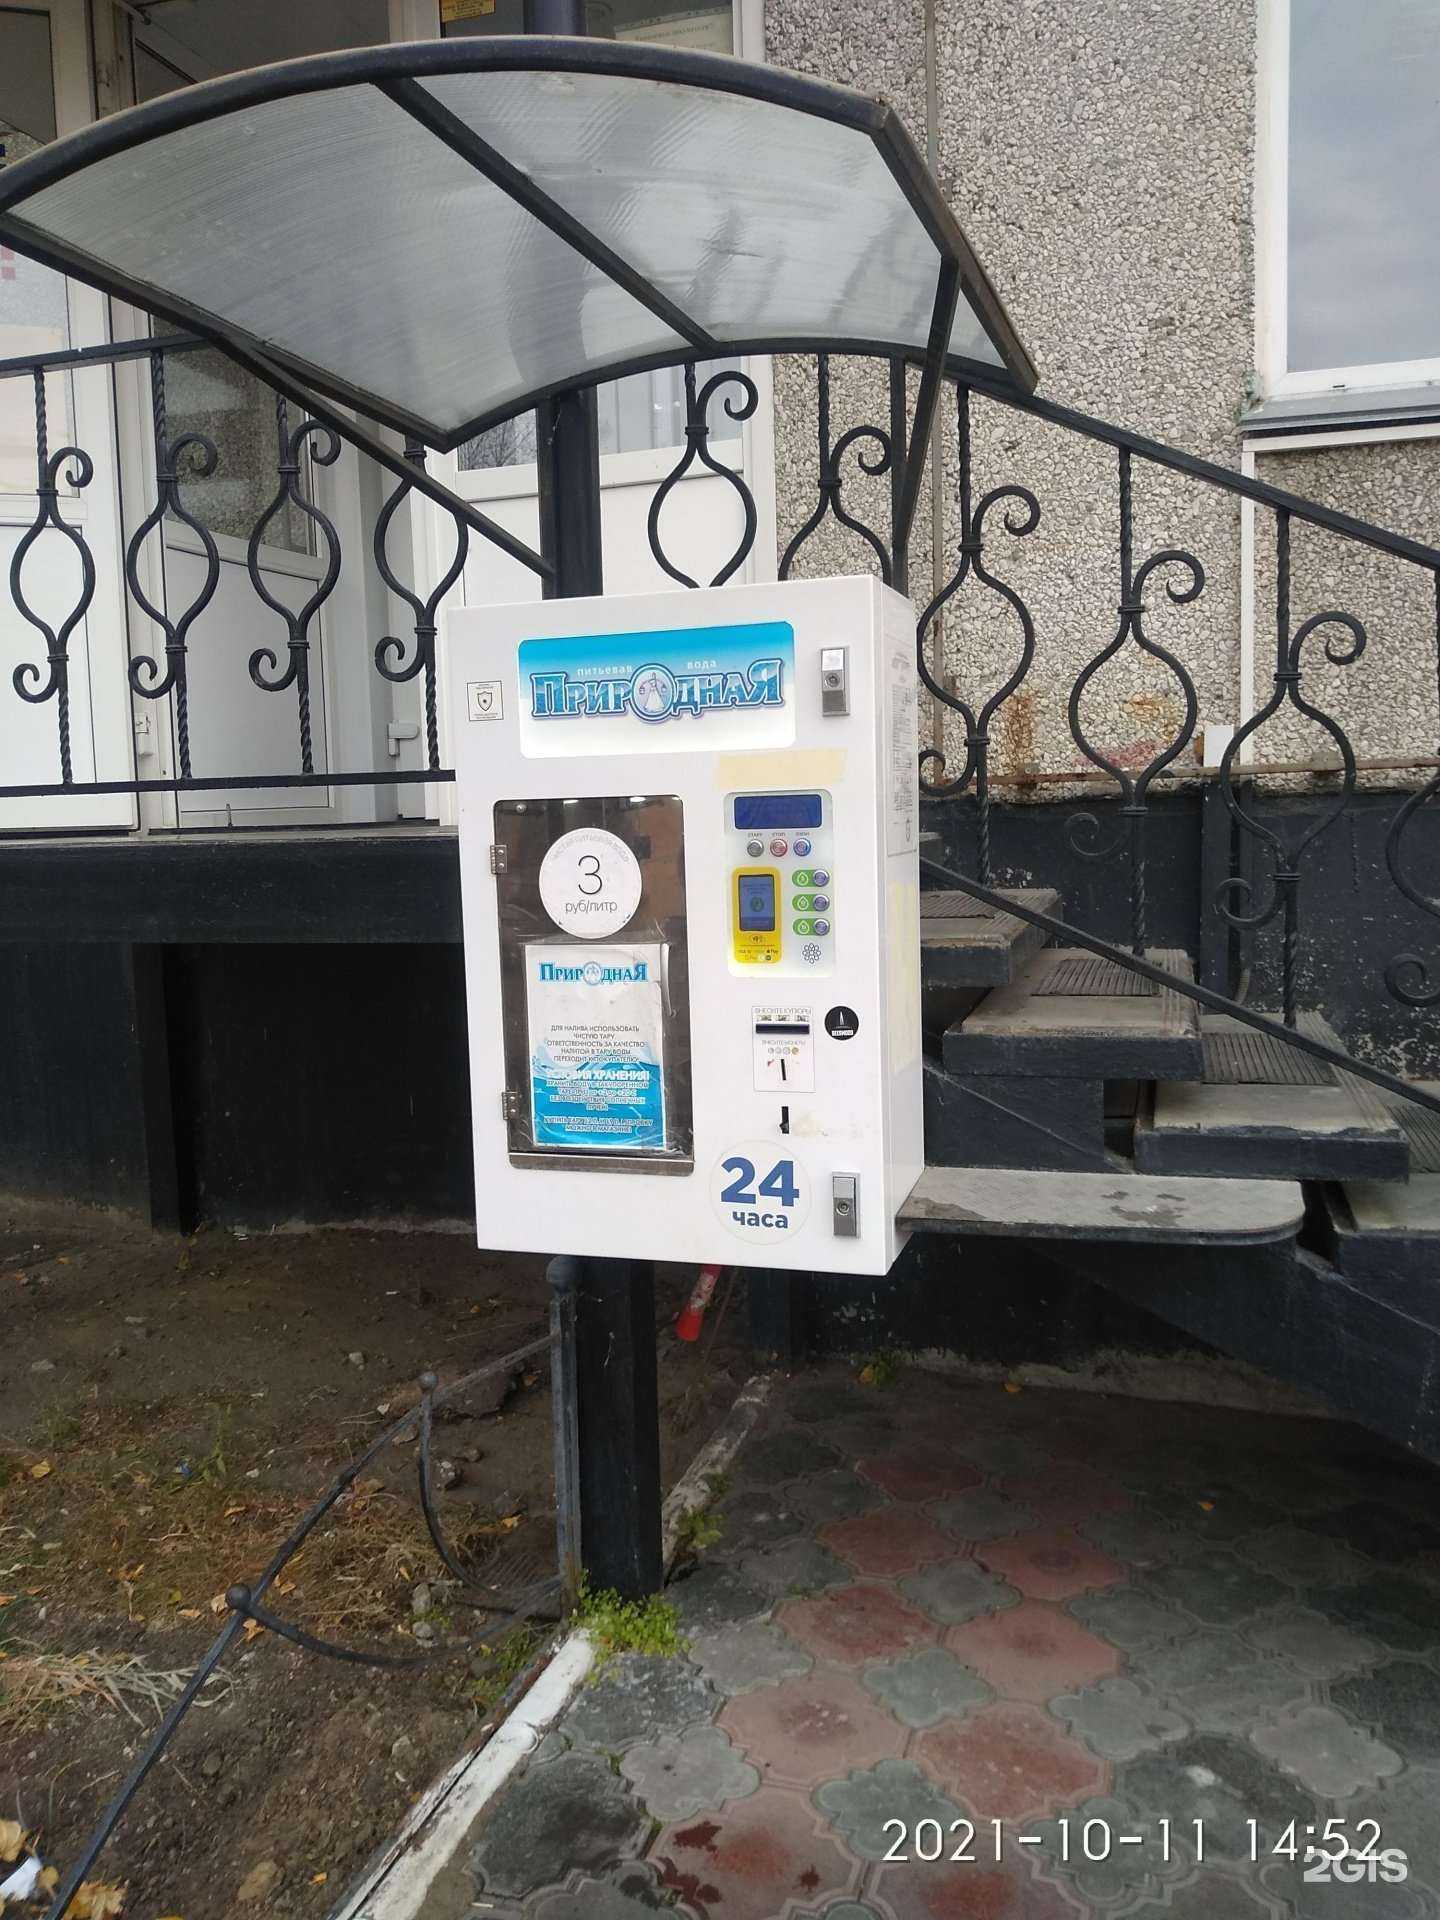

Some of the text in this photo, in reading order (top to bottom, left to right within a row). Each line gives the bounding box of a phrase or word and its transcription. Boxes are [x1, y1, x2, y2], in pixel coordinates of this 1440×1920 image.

[577, 659, 717, 676] питьевая вода
[578, 855, 603, 895] 3
[565, 900, 618, 914] руб/литр
[593, 1070, 650, 1081] ХРАНЕНИЯ!
[721, 1157, 799, 1207] 24
[732, 1211, 788, 1229] часа
